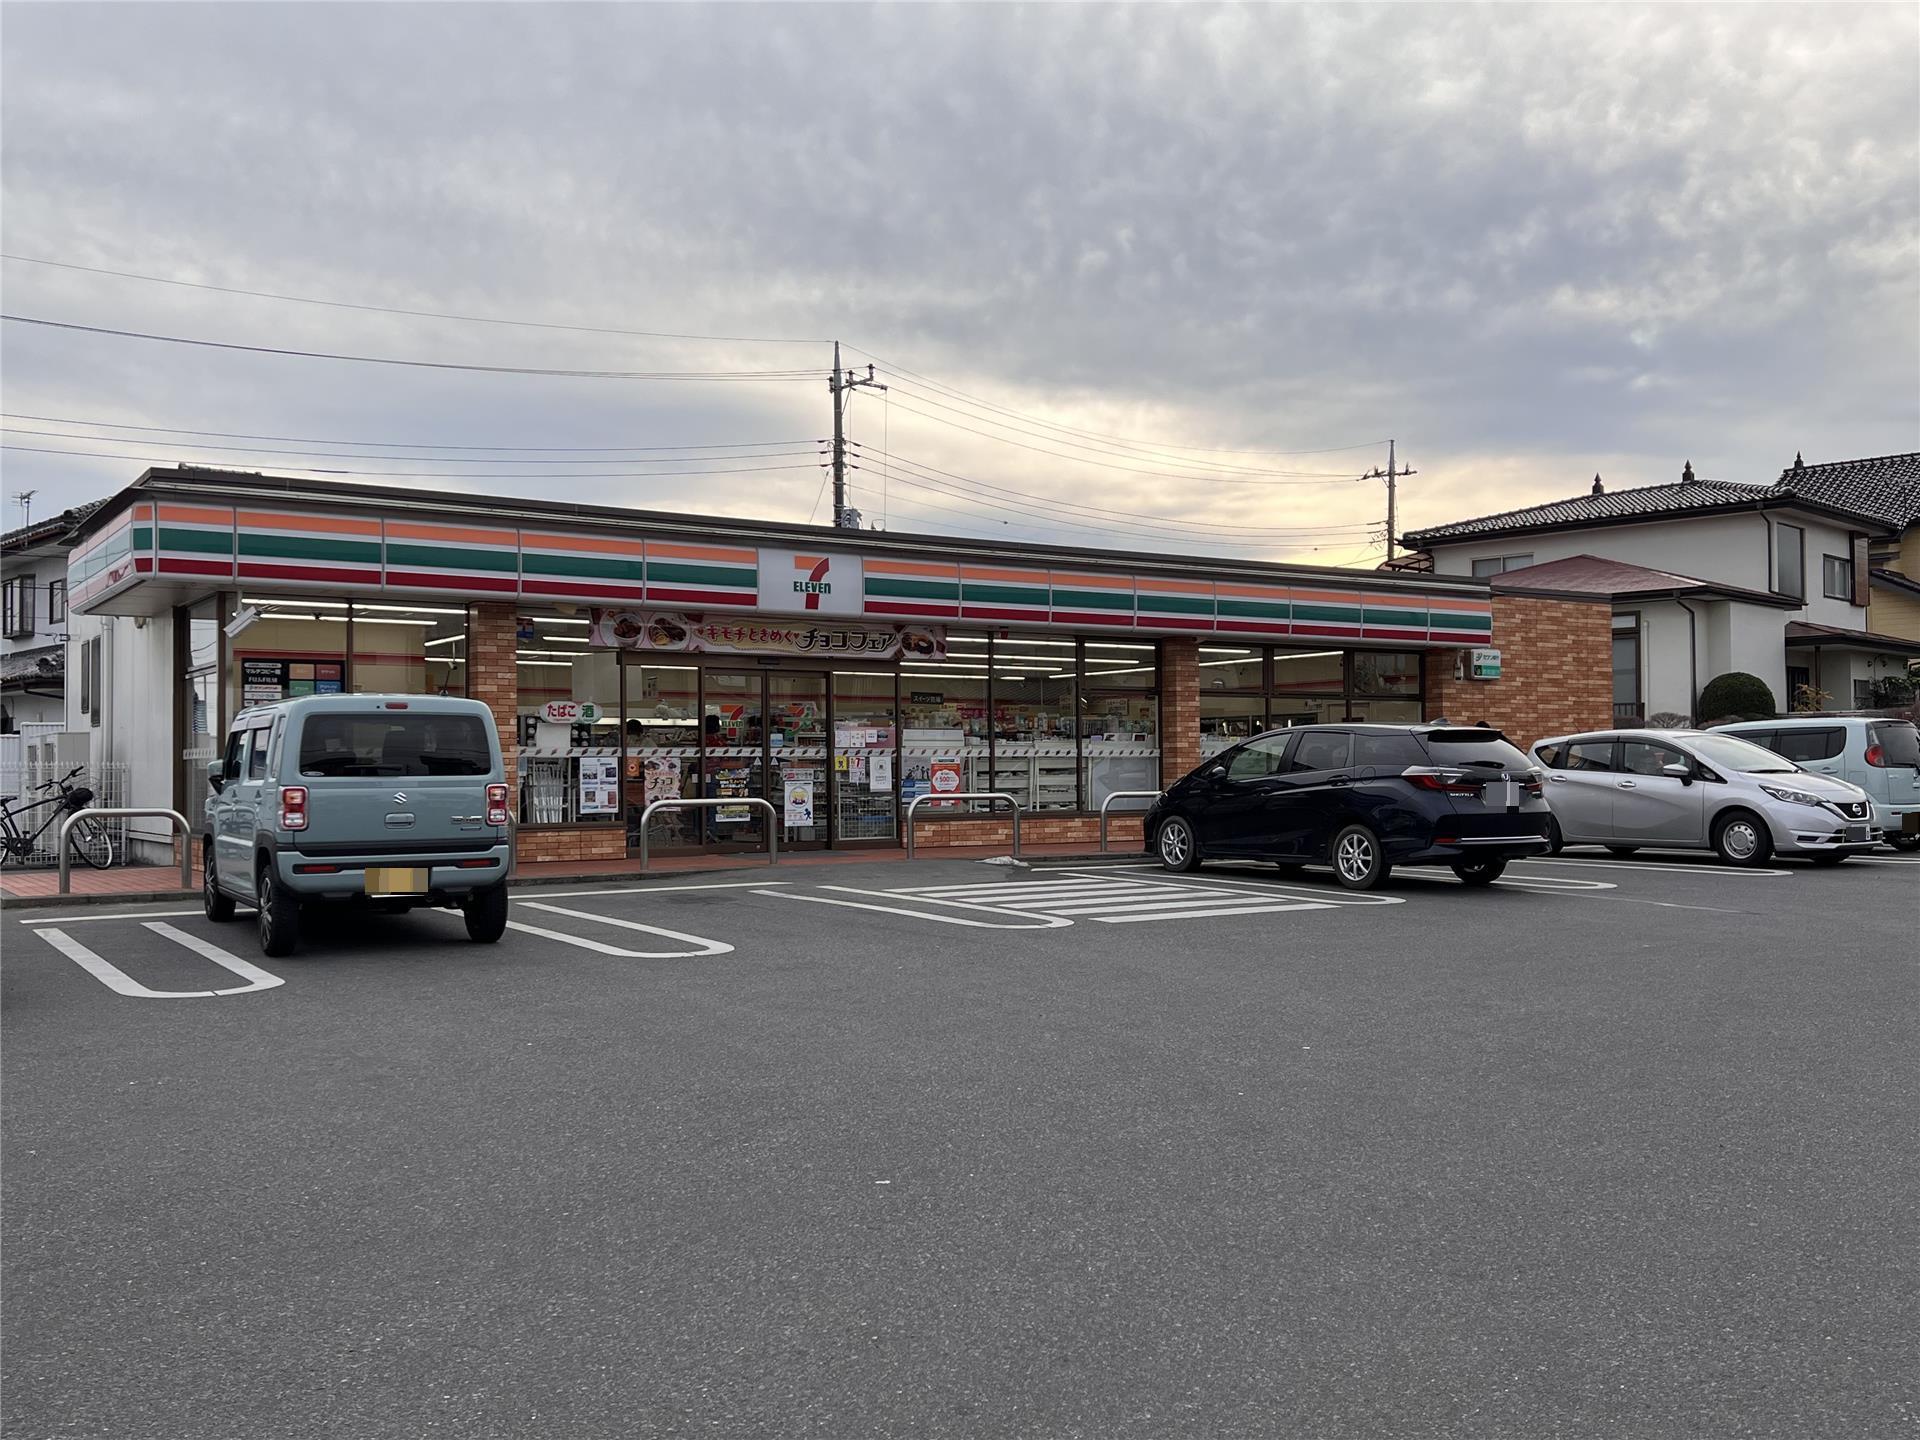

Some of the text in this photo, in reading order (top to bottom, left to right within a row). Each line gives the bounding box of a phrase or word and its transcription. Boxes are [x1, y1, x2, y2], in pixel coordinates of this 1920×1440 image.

[794, 556, 829, 610] 7
[797, 628, 897, 651] チョコフェア
[547, 704, 576, 718] たばこ
[582, 704, 594, 718] 酒
